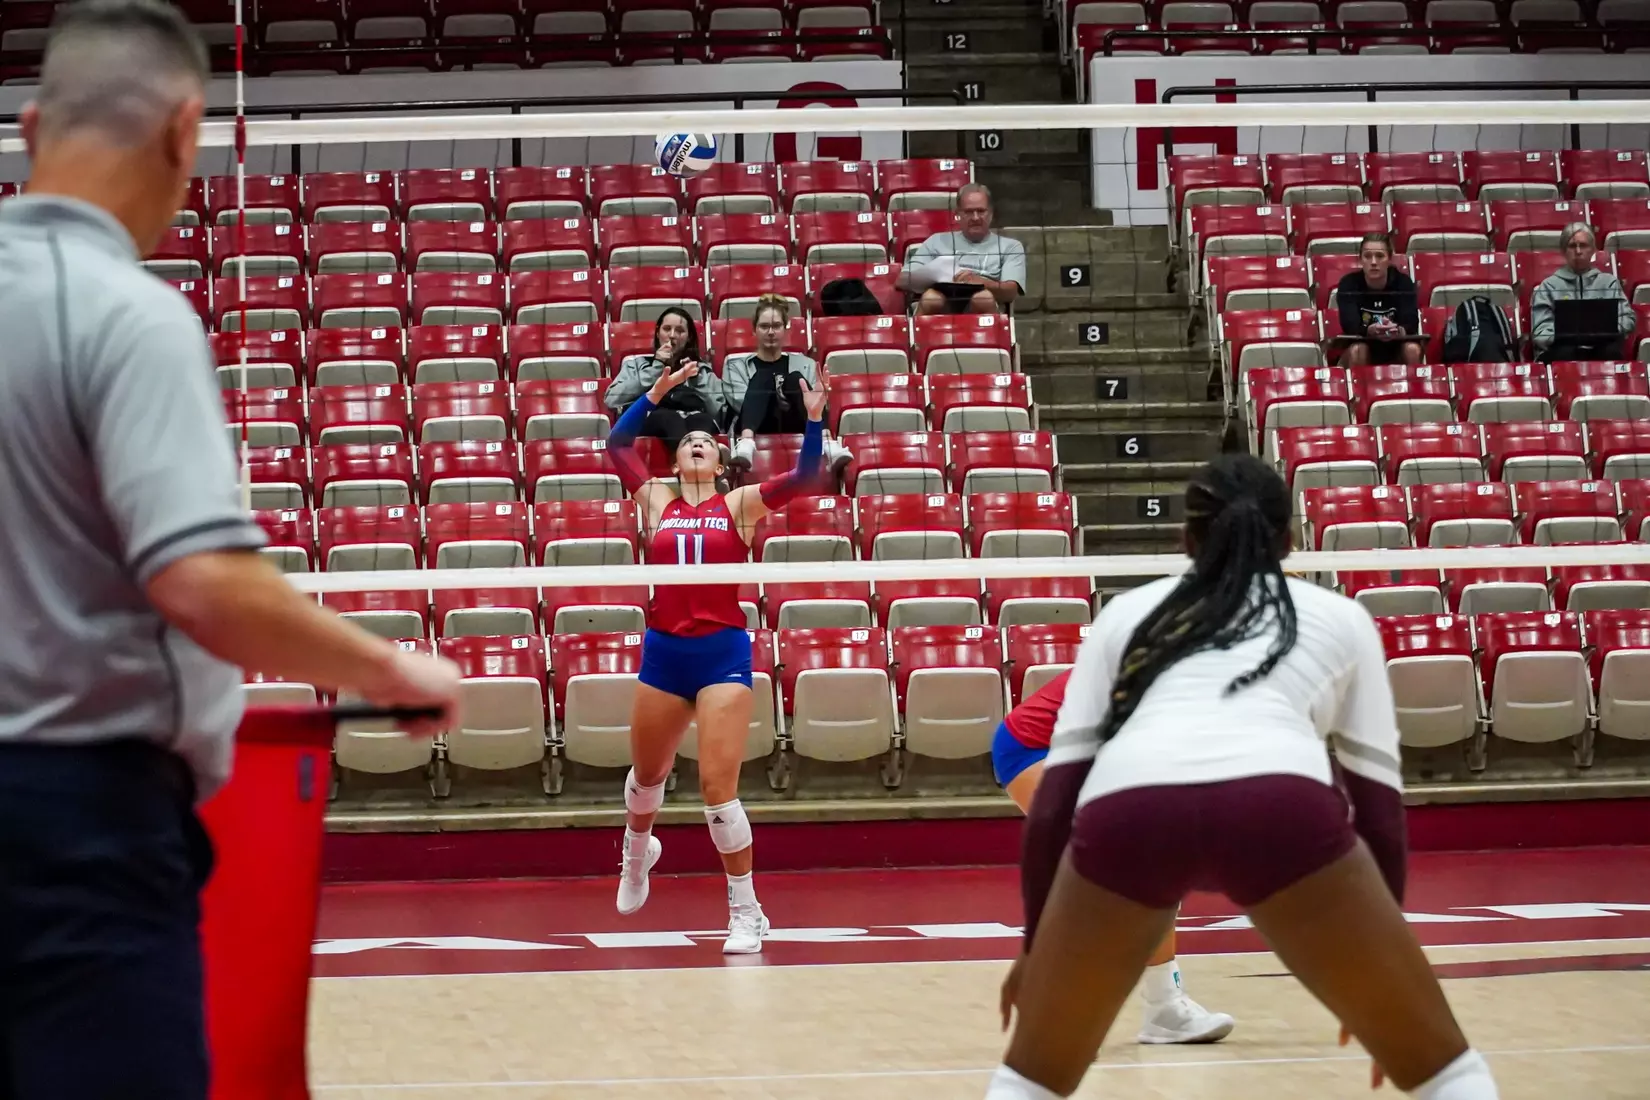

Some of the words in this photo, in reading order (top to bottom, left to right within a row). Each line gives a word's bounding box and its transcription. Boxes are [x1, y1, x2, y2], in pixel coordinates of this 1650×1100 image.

[947, 34, 966, 49] 12
[964, 83, 979, 99] 11
[979, 133, 1000, 149] 10
[1135, 79, 1238, 190] H
[671, 140, 692, 172] molten
[1068, 268, 1082, 284] 9
[1086, 326, 1100, 342] 8
[1106, 380, 1119, 396] 7
[1124, 438, 1139, 454] 6
[1147, 500, 1160, 517] 5
[704, 516, 728, 532] TECH
[675, 533, 704, 564] 11
